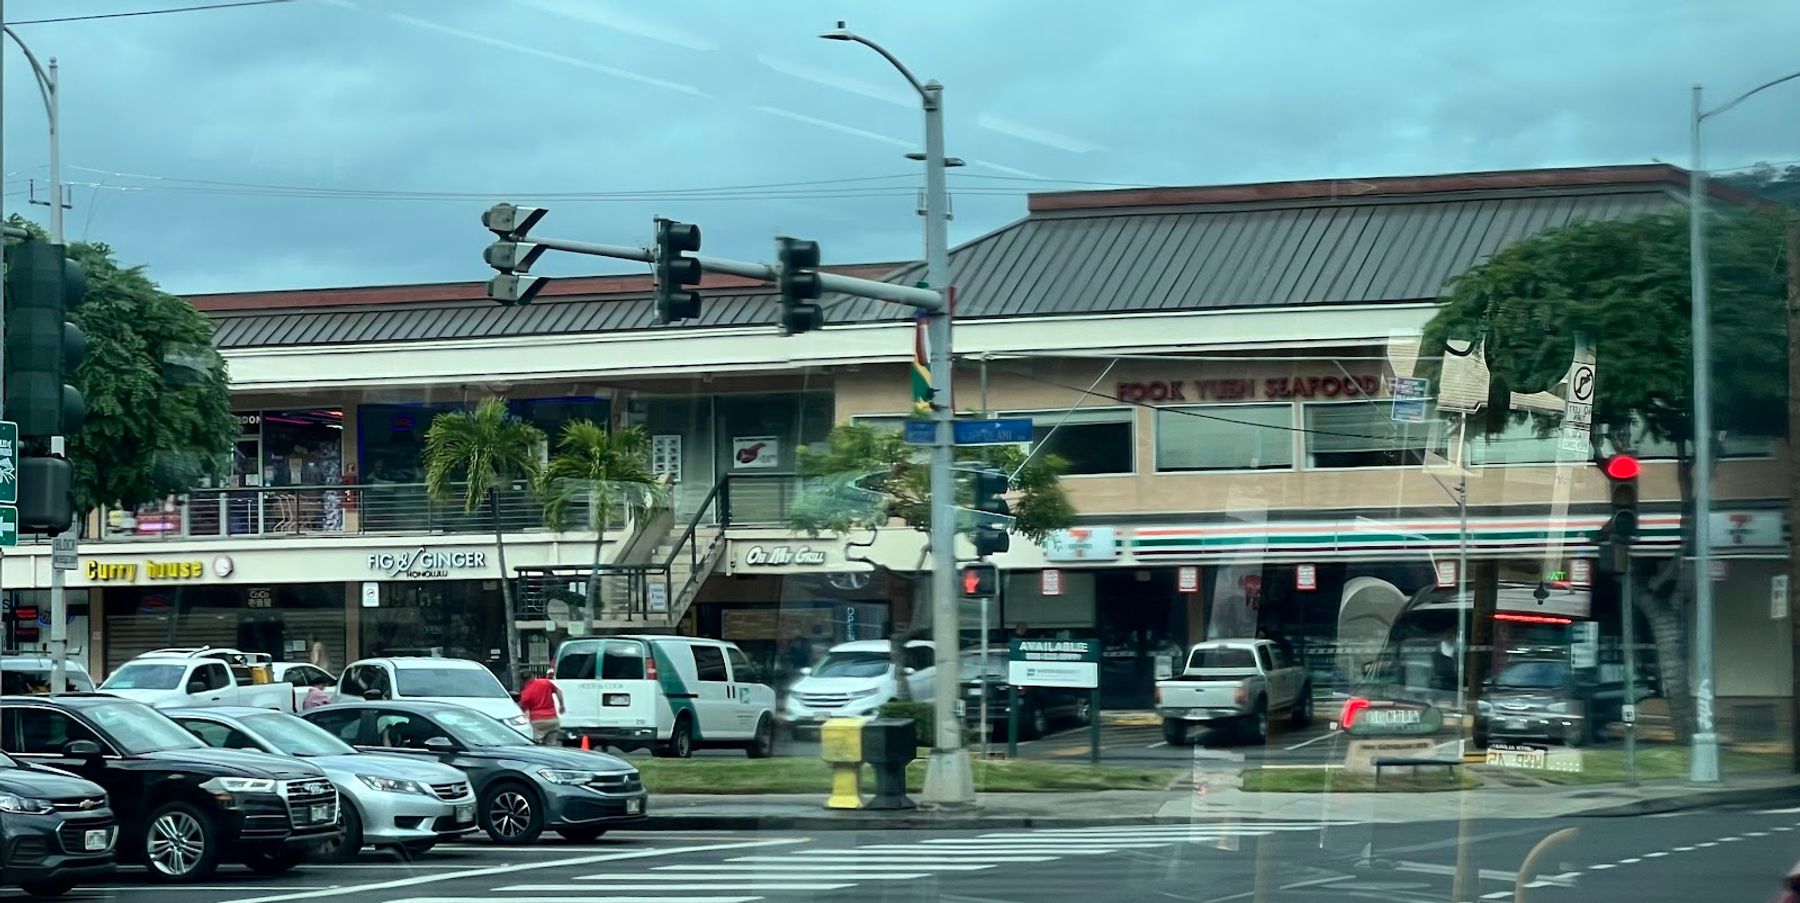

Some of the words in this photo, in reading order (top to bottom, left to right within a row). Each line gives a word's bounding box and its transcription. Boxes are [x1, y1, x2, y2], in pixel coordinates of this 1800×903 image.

[1116, 381, 1185, 401] FOOK
[1264, 375, 1381, 397] SEAFOOD
[368, 554, 394, 569] FIG
[420, 552, 486, 568] GINGER
[86, 560, 137, 582] Curry
[146, 560, 204, 579] house
[1018, 641, 1089, 653] AVAILABLE
